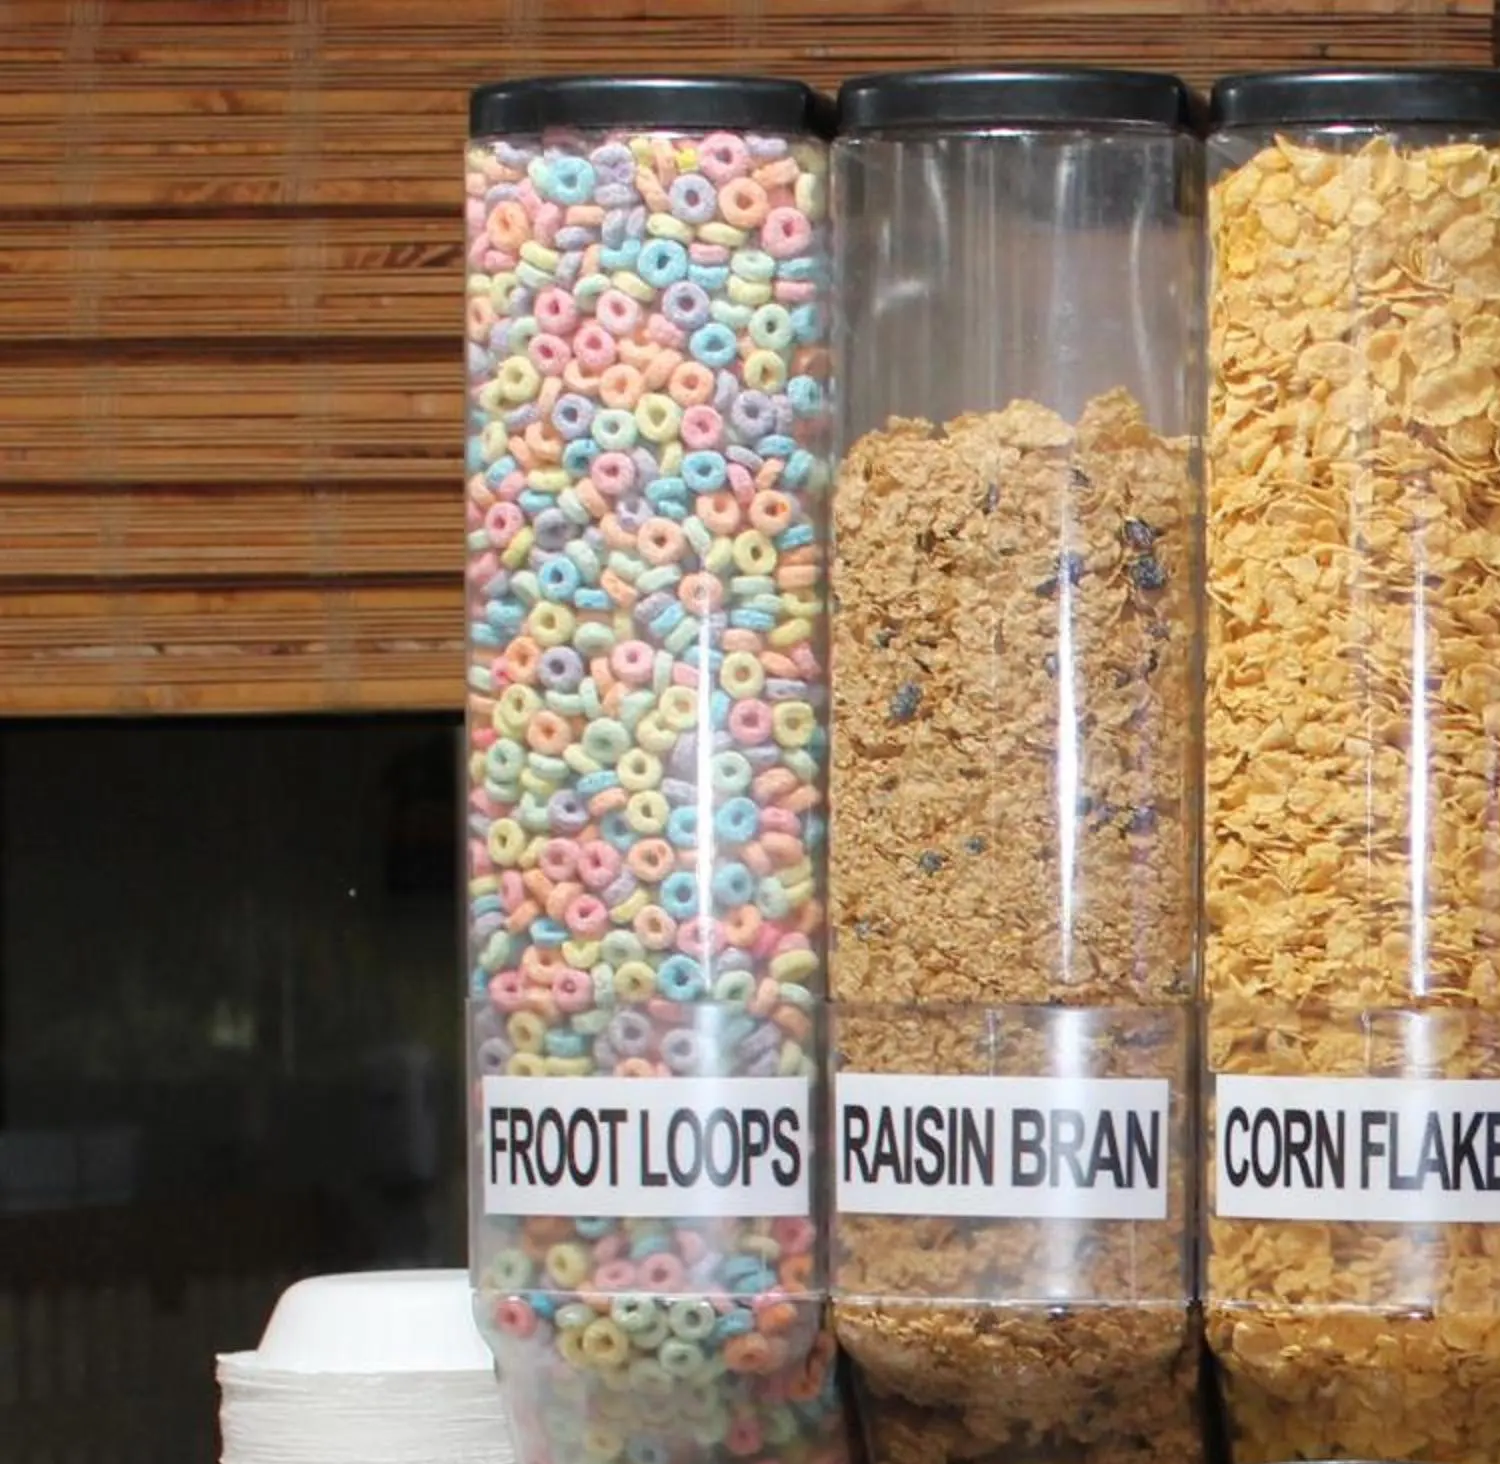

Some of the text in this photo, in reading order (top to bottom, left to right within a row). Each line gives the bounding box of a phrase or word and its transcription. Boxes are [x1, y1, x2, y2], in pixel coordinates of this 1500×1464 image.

[489, 1106, 801, 1188] FROOT LOOPS
[843, 1104, 1160, 1189] RAISIN BRAN
[1224, 1105, 1346, 1189] CORN
